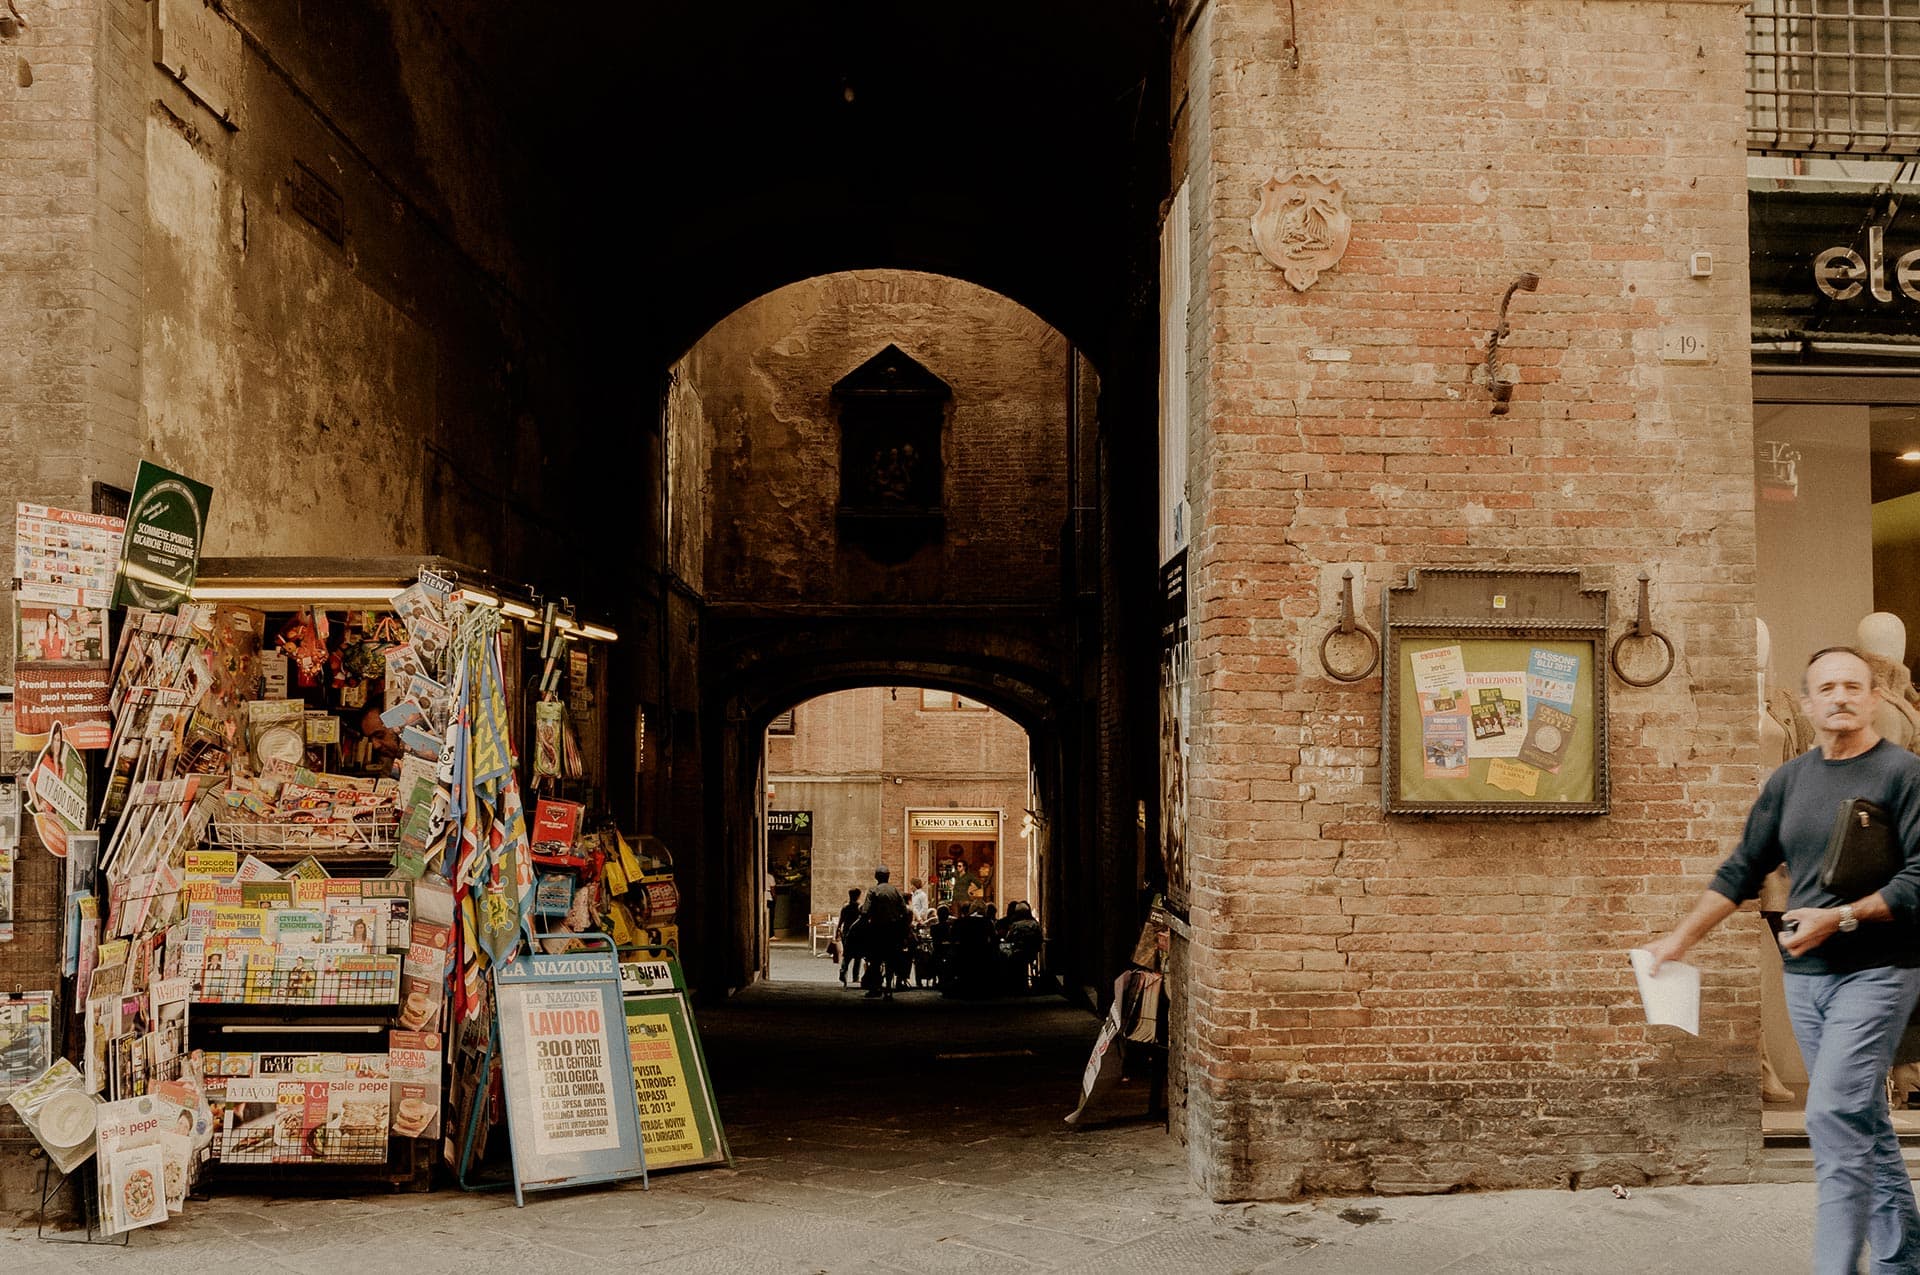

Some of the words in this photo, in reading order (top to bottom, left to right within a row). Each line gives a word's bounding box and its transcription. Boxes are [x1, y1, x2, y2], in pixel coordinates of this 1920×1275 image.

[1679, 335, 1697, 354] 19
[71, 513, 106, 527] VENDITA
[138, 522, 170, 541] SCOMMESSE
[421, 575, 451, 594] SIENA
[19, 680, 48, 689] Prendi
[49, 681, 67, 689] una
[61, 692, 94, 701] vincere
[29, 704, 65, 715] Jackpot
[948, 819, 964, 827] DEI
[966, 819, 994, 827] GALLI
[187, 865, 235, 874] enigmistica
[199, 859, 234, 867] raccolta
[216, 913, 261, 921] ENIGMISTICA
[532, 959, 613, 976] NAZIONE
[637, 964, 669, 980] SIENA
[526, 991, 542, 1005] LA
[545, 990, 599, 1004] NAZIONE
[528, 1009, 601, 1037] LAVORO
[537, 1040, 573, 1058] 300
[575, 1038, 601, 1056] POSTI
[390, 1050, 426, 1062] CUCINA
[537, 1058, 553, 1071] PER
[554, 1057, 564, 1070] LA
[566, 1055, 603, 1070] CENTRALE
[544, 1069, 599, 1085] ECOLOGICA
[642, 1075, 676, 1089] TIROIDE?
[330, 1081, 354, 1091] sale
[359, 1082, 388, 1093] pepe
[547, 1084, 571, 1098] NELLA
[572, 1082, 606, 1097] CHIMICA
[638, 1089, 668, 1102] RIPASSI
[561, 1099, 583, 1110] SPESA
[583, 1097, 607, 1108] GRATIS
[576, 1107, 609, 1118] ARRESTATA
[129, 1119, 158, 1136] pepe
[656, 1129, 685, 1142] DIRIGENTI
